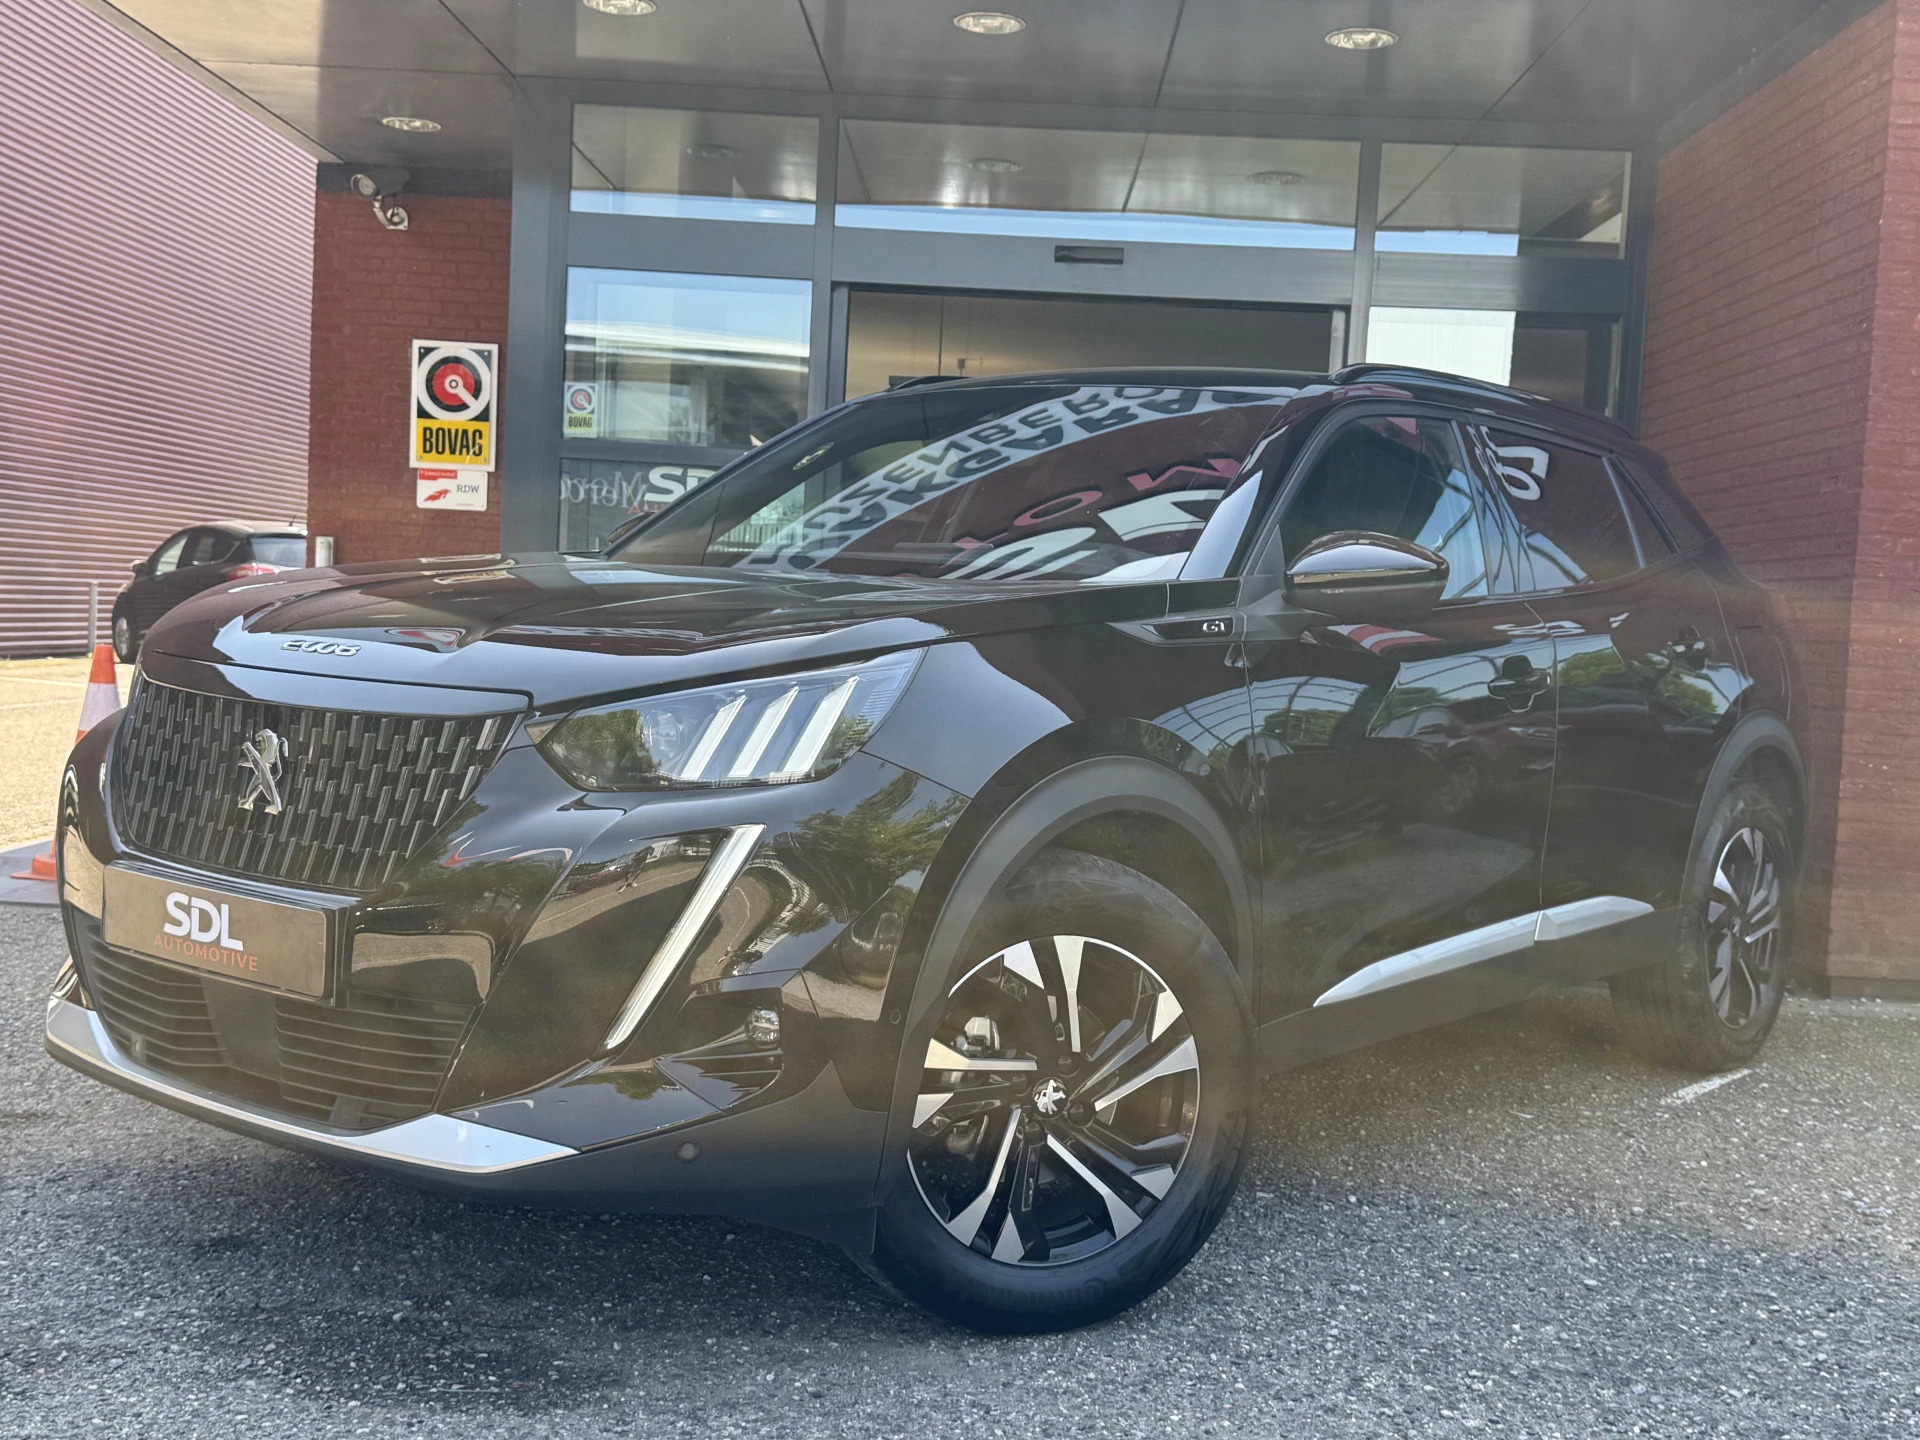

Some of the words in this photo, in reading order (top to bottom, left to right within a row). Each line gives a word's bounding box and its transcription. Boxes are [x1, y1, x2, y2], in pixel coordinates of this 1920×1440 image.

[568, 415, 593, 428] BOVAG
[422, 426, 483, 457] BOVAG
[456, 484, 480, 494] RDW
[281, 639, 361, 657] 2008
[163, 891, 244, 951] SDL
[153, 933, 259, 972] AUTOMOTIVE
